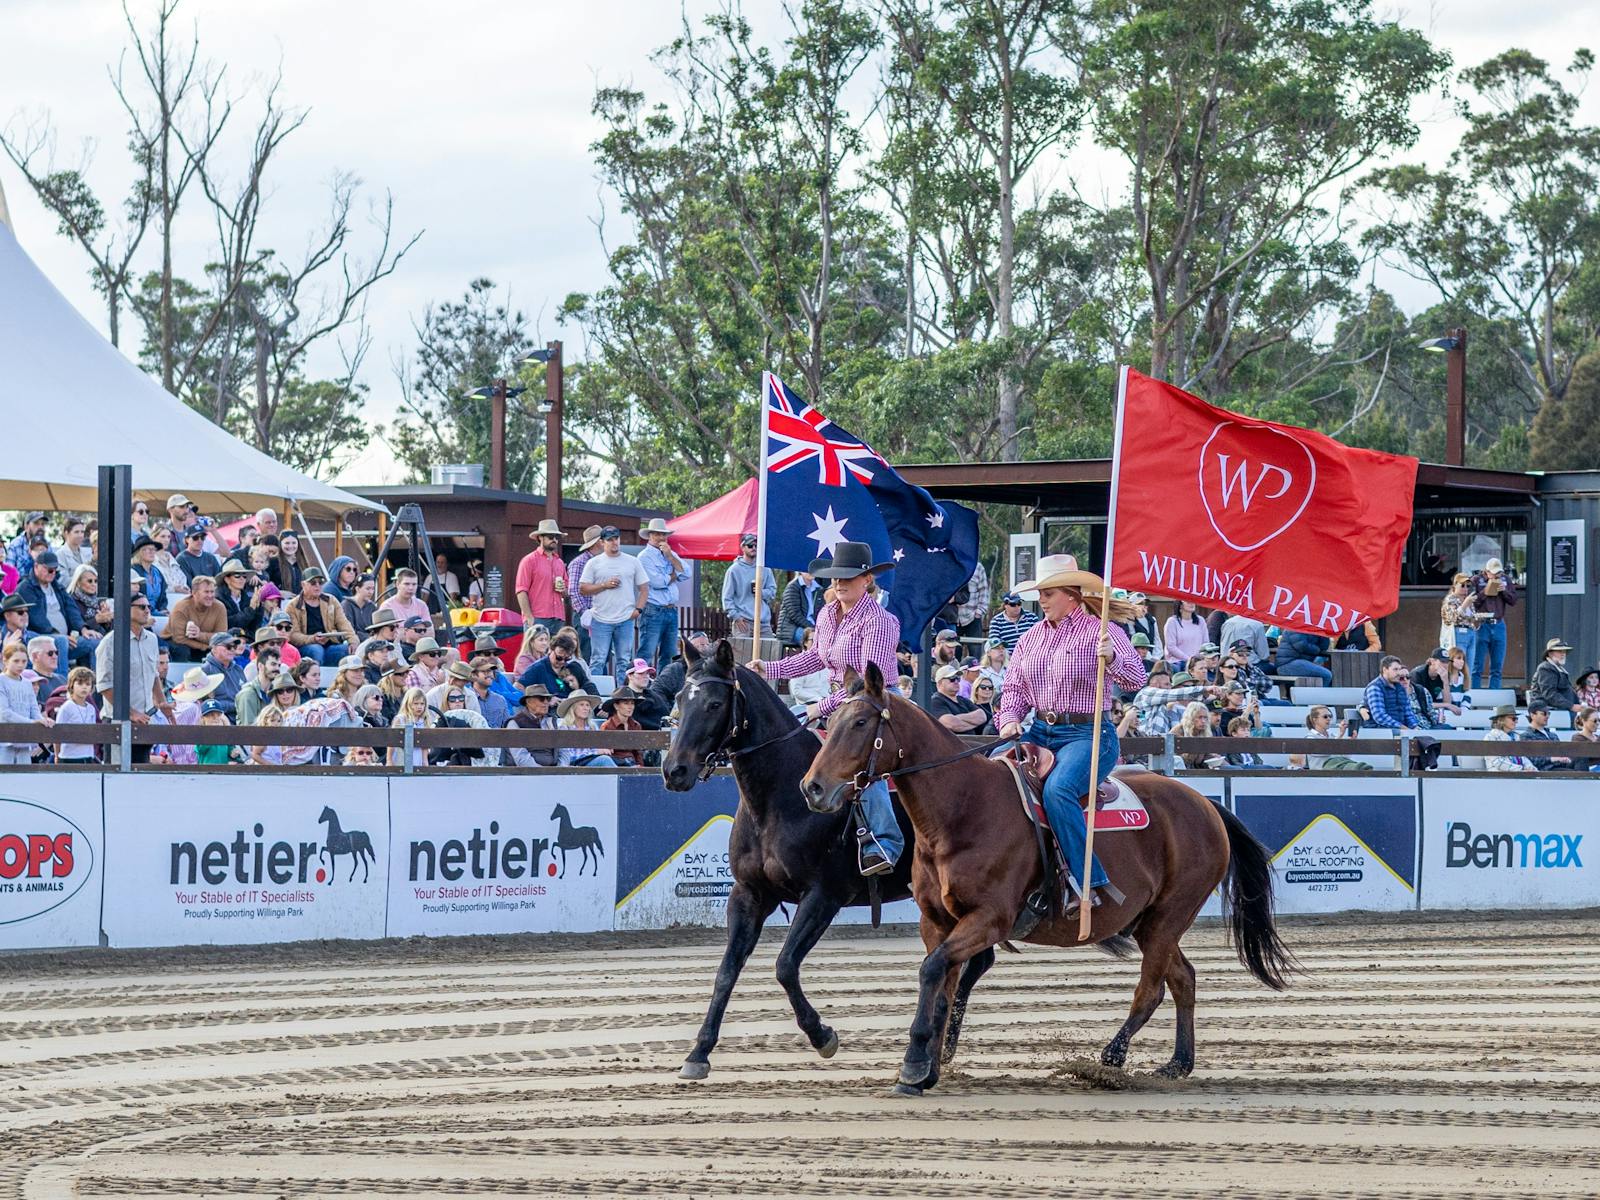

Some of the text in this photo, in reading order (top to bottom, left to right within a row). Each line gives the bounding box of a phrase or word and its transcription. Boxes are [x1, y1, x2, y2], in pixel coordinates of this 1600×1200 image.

[1217, 453, 1293, 513] WP
[1138, 550, 1256, 611] WILLINGA
[1119, 811, 1141, 825] WP
[1293, 846, 1313, 855] BAY
[1324, 845, 1360, 855] COAST
[1446, 821, 1583, 868] Benmax
[684, 853, 708, 864] BAY
[1286, 857, 1365, 867] METAL ROOFING
[675, 867, 714, 878] METAL
[1287, 871, 1360, 882] baycoastroofing.com.au
[16, 883, 23, 893] &
[25, 882, 64, 893] ANIMALS
[414, 884, 546, 899] Your Stable of IT Specialists
[1307, 884, 1339, 892] 4472 7373
[176, 889, 315, 905] Your Stable of IT Specialists
[184, 907, 304, 920] Proudly Supporting Willinga Park
[422, 900, 536, 914] Proudly Supporting Willinga Park
